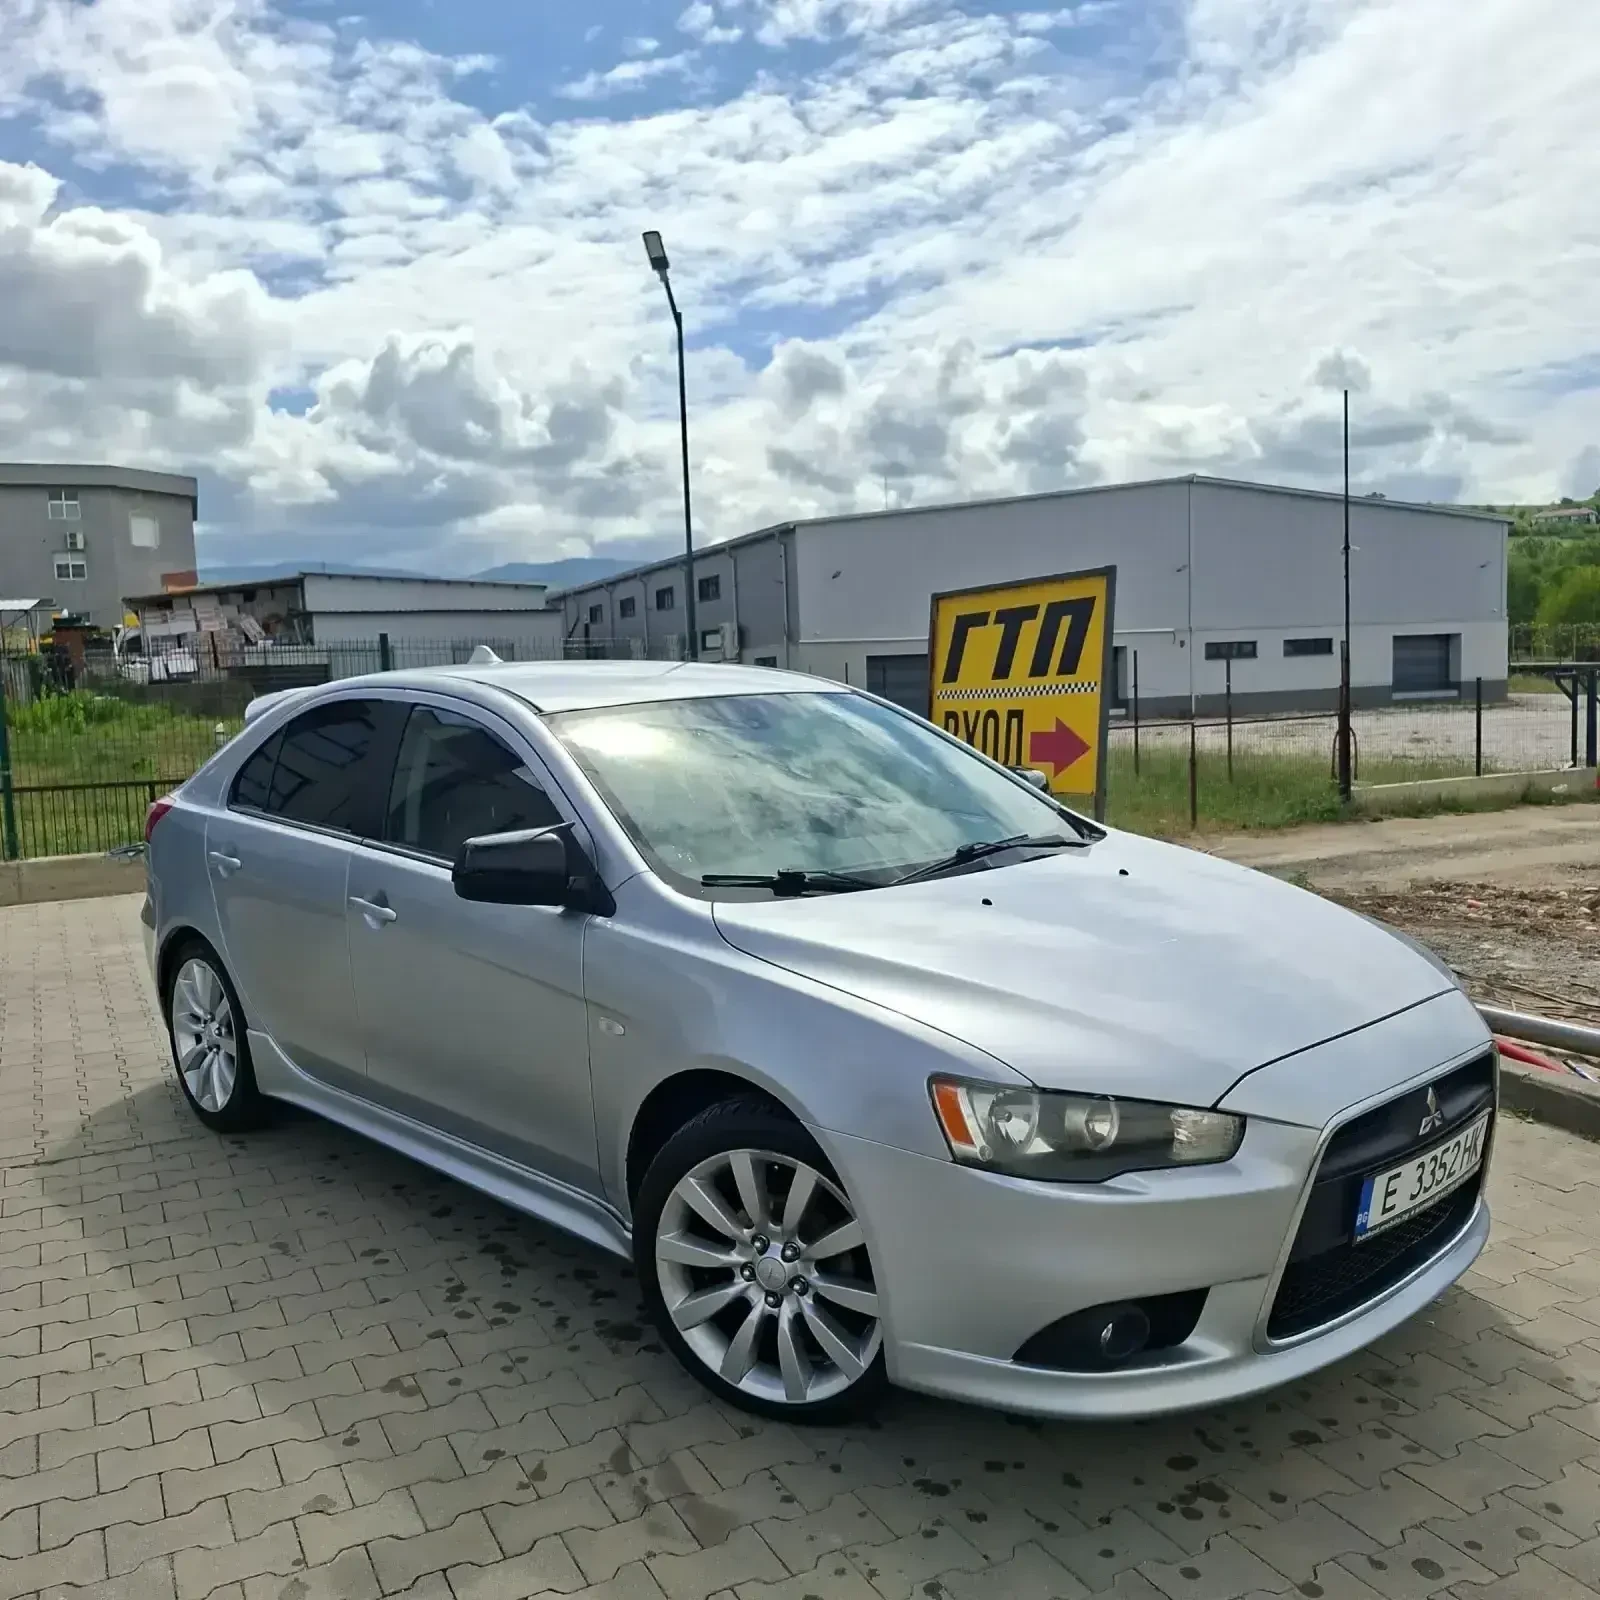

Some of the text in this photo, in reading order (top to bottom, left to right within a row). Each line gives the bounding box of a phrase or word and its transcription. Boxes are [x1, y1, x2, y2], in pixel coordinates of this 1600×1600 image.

[942, 596, 1096, 683] ГТП
[1381, 1171, 1402, 1216] E
[1356, 1211, 1369, 1226] BG
